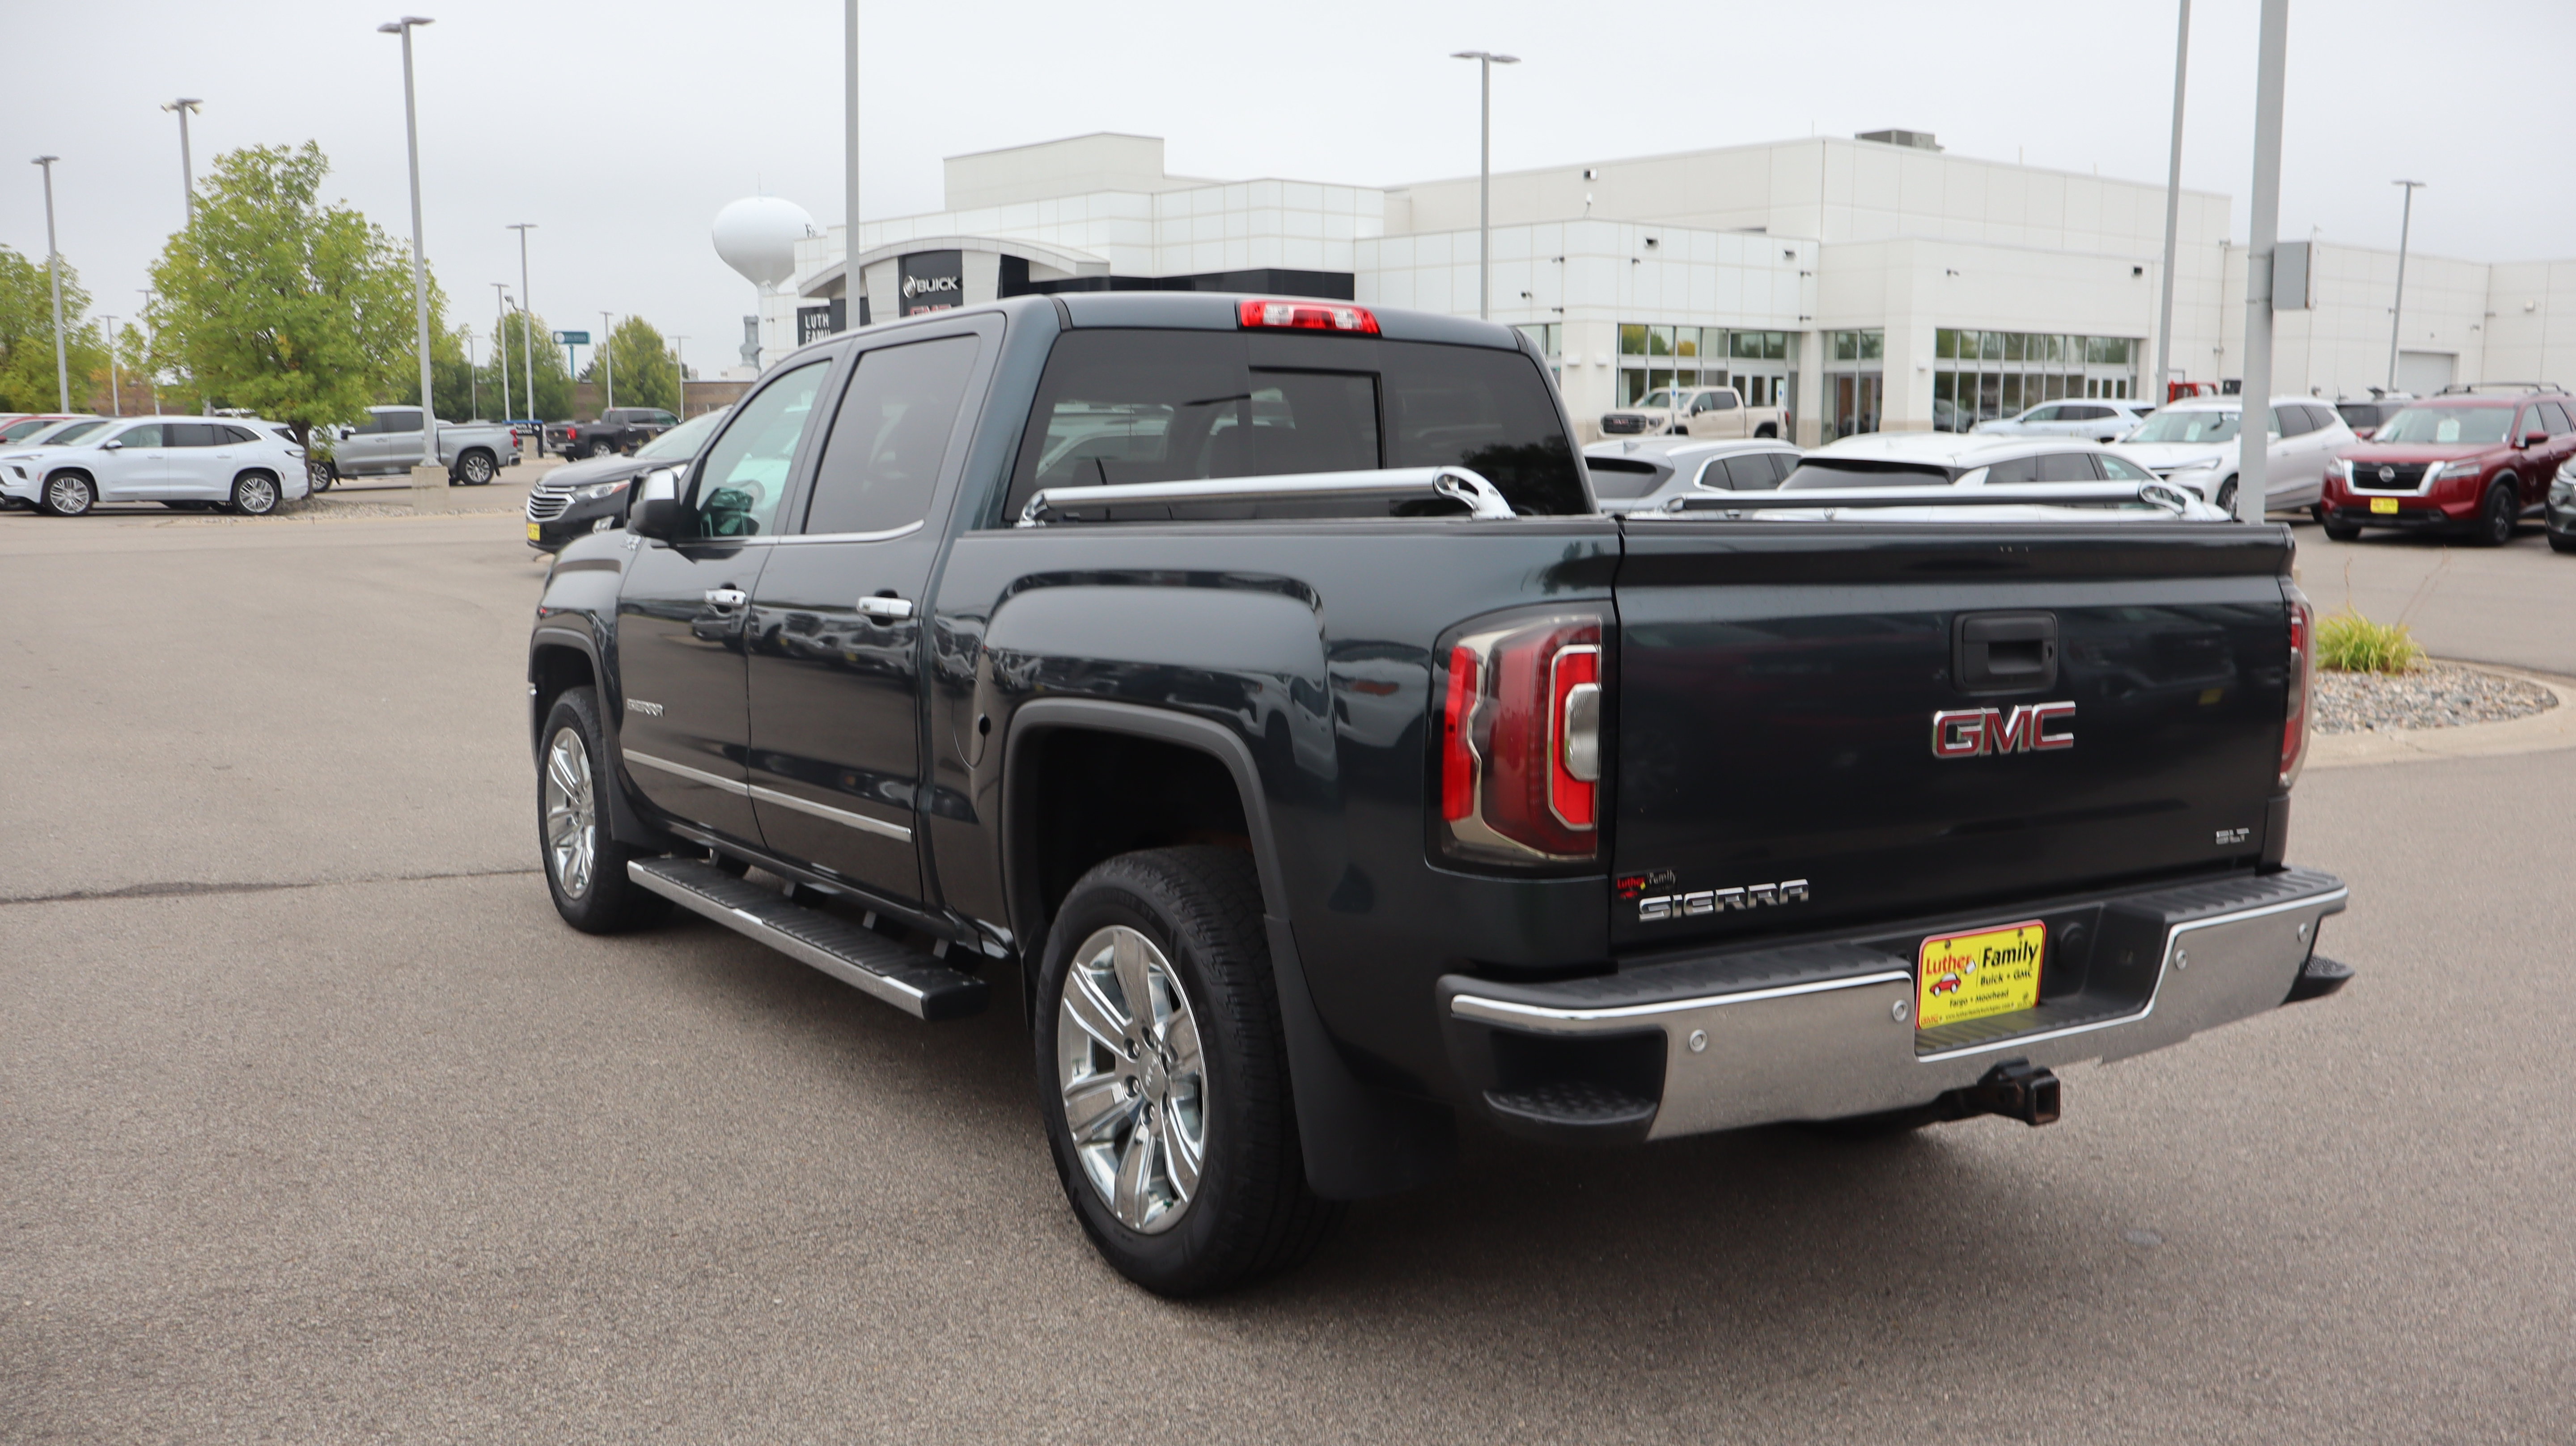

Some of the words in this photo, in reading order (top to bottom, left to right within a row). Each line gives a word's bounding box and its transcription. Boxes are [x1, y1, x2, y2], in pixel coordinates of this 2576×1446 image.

[916, 276, 958, 293] BUICK
[1932, 700, 2076, 759] GMC
[2216, 827, 2250, 845] SLT
[1639, 878, 1809, 923] SIERRA
[1926, 954, 1972, 975] Luther
[1982, 940, 2038, 971] Family
[1981, 972, 2003, 986] Buick
[1975, 988, 2009, 1003] Moorhead
